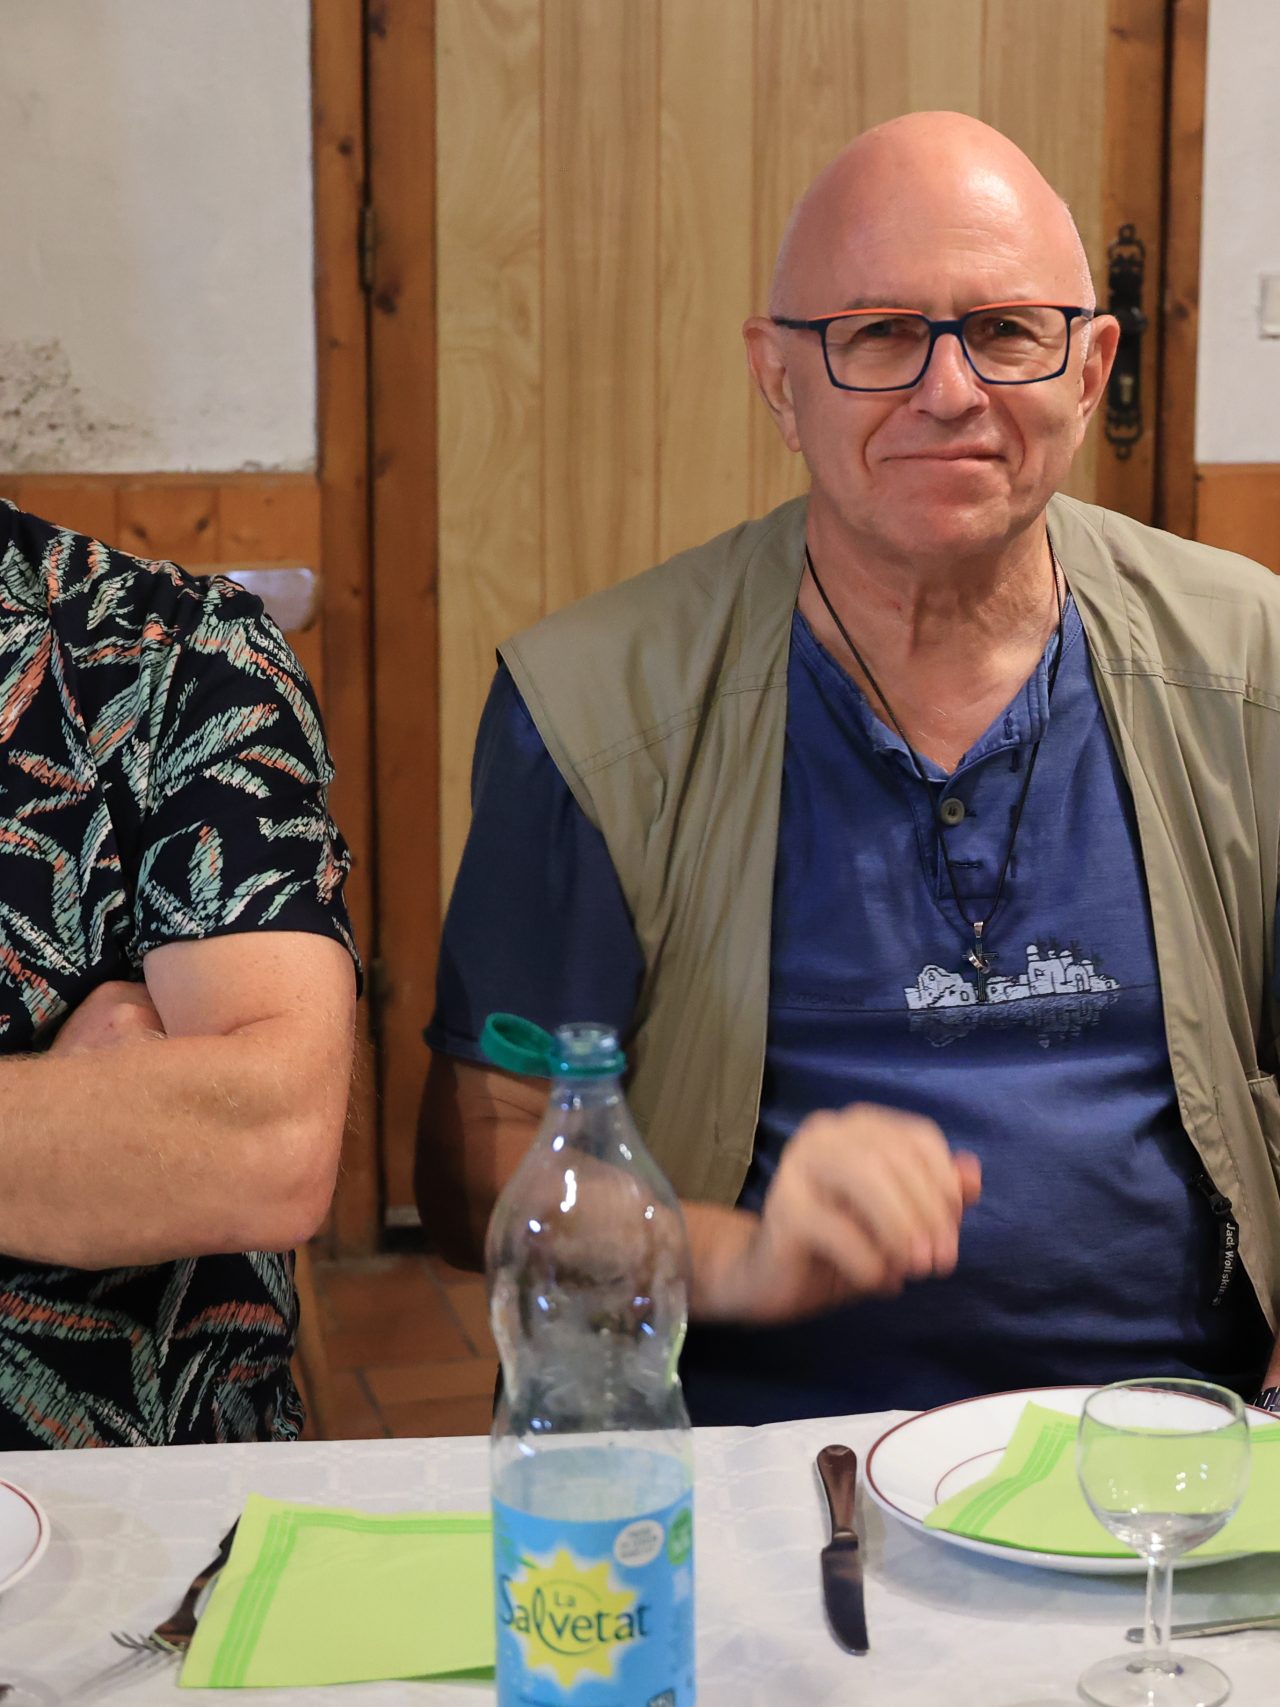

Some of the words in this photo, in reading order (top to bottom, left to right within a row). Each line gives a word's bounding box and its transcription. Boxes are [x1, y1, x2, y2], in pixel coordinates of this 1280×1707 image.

[1225, 1222, 1236, 1248] Jack
[554, 1590, 577, 1608] La
[500, 1575, 650, 1655] Salvetat
